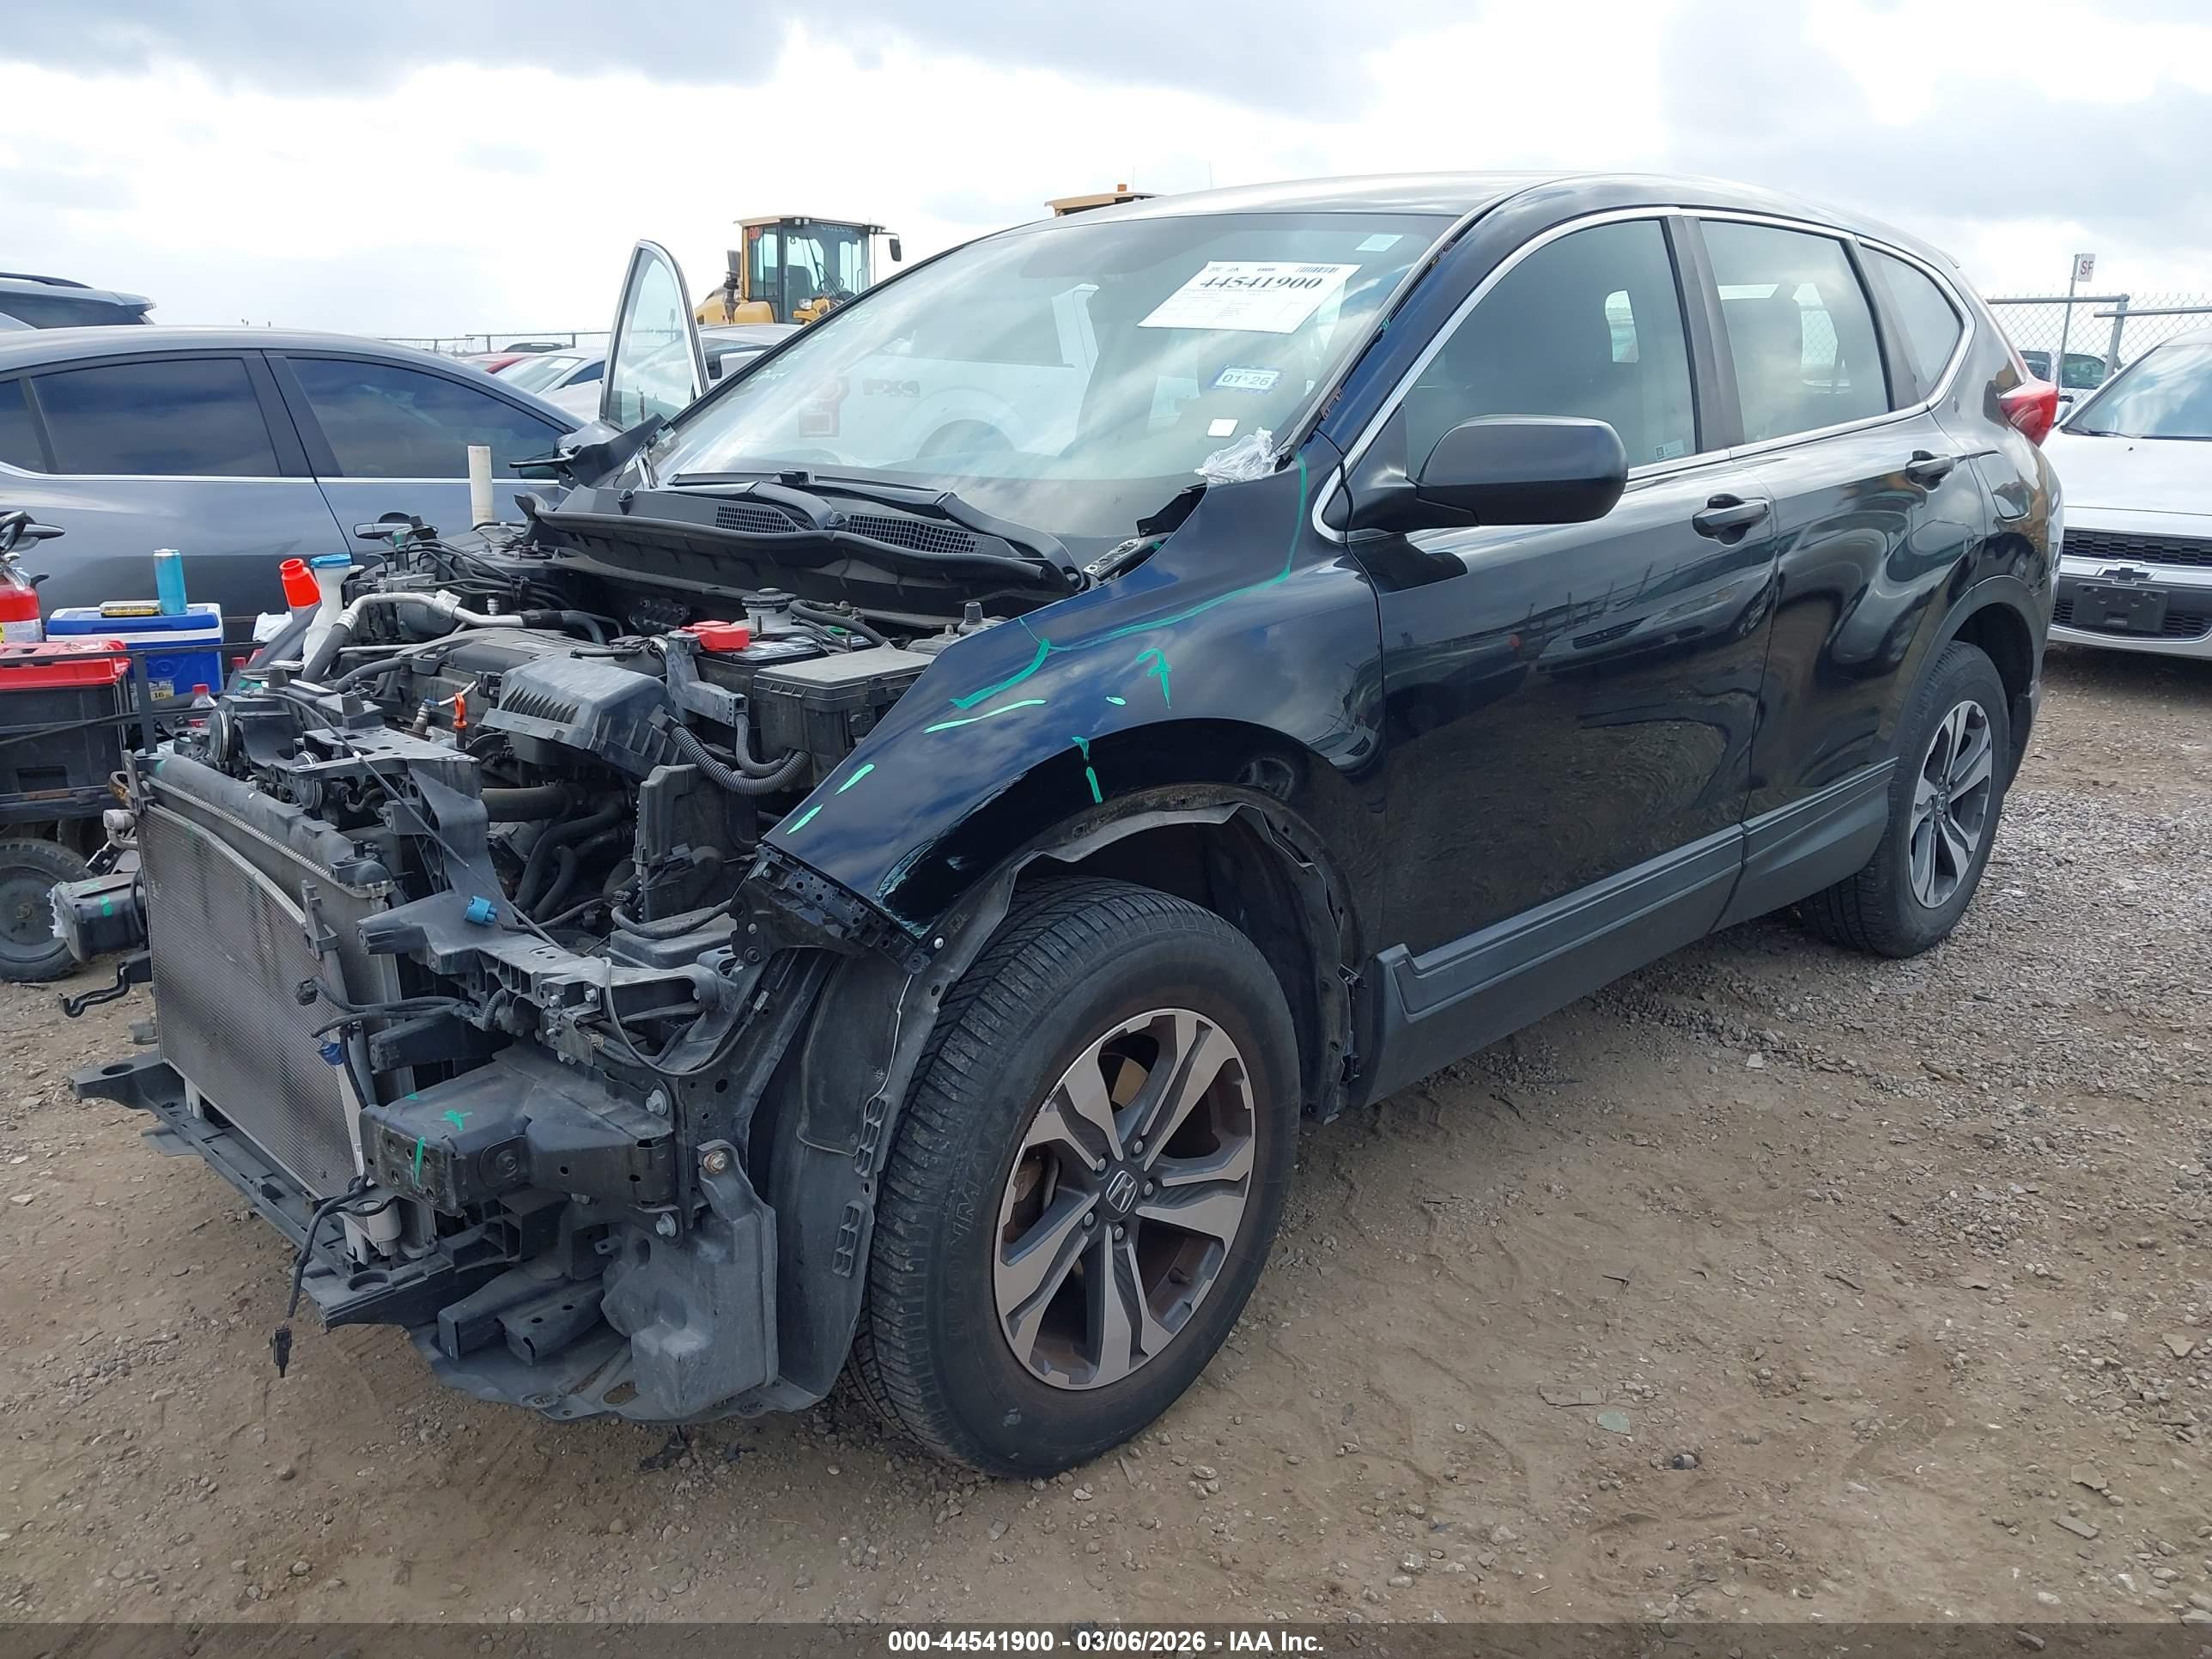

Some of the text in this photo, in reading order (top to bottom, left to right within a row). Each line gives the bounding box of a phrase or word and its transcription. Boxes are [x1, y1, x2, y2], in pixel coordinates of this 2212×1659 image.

[749, 227, 760, 240] 80
[2081, 260, 2094, 275] SF
[1200, 276, 1323, 289] 44541900
[1222, 374, 1271, 386] 01 26
